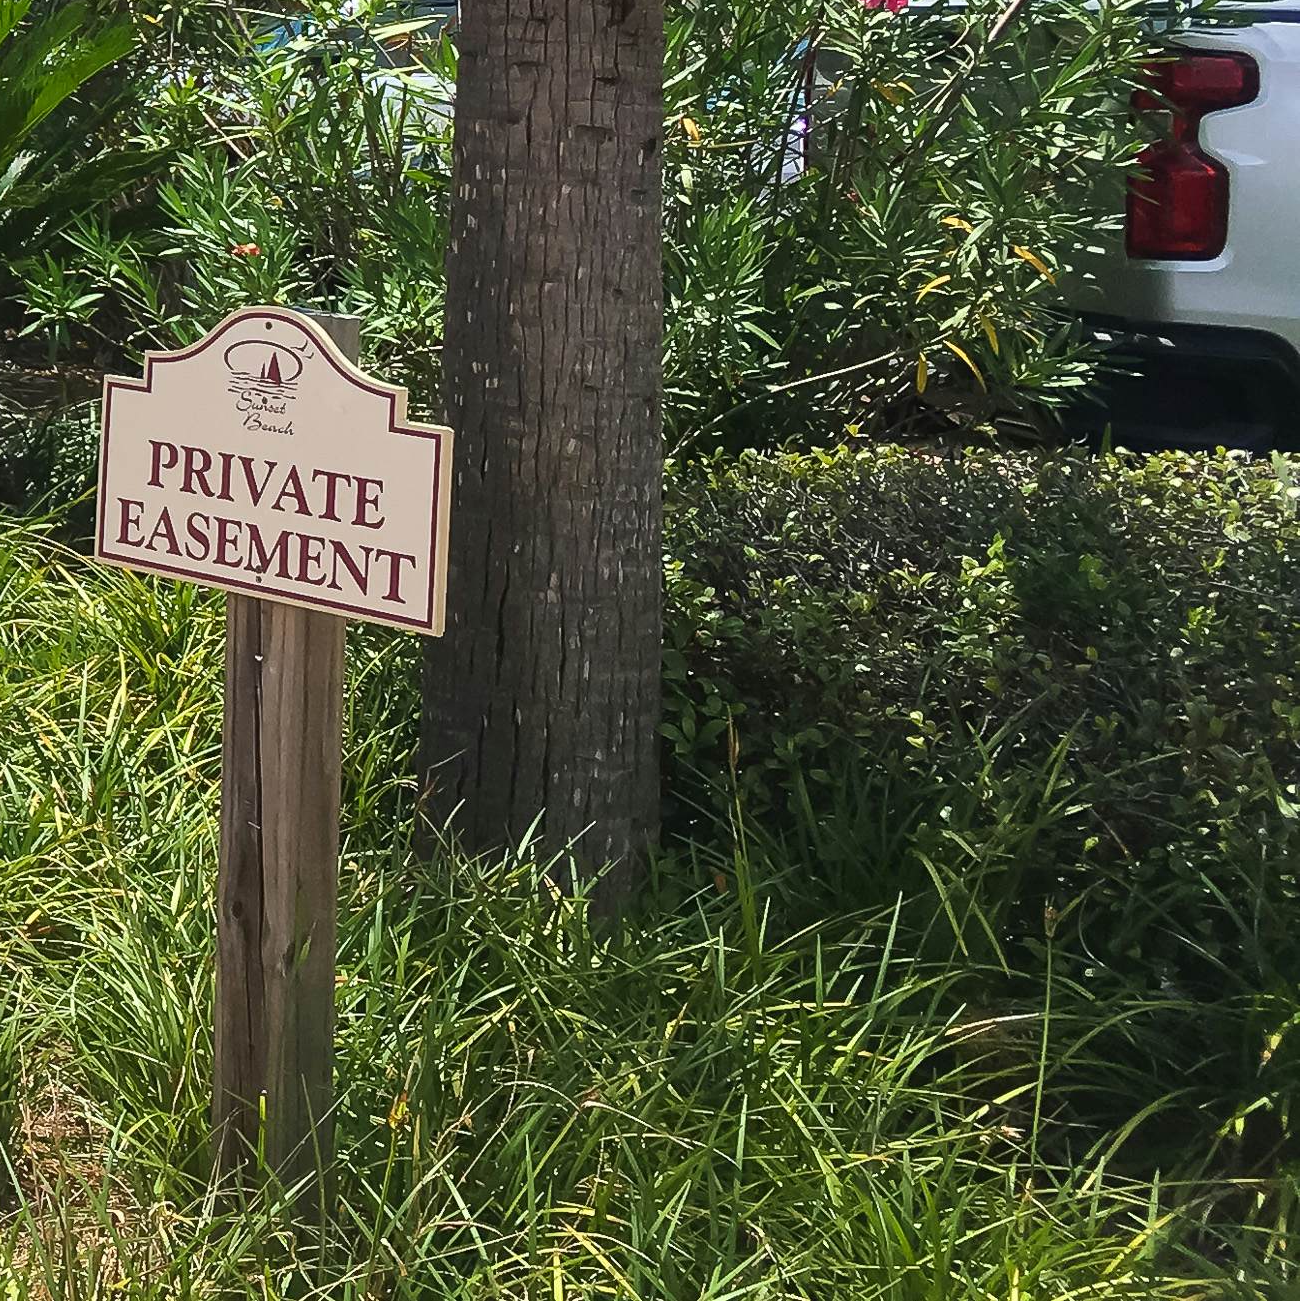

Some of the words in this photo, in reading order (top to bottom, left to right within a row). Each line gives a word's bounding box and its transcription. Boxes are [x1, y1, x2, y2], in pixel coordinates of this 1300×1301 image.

[235, 391, 287, 415] Sunset
[243, 412, 295, 436] Beach
[147, 439, 386, 531] PRIVATE
[116, 497, 417, 605] EASEMENT
